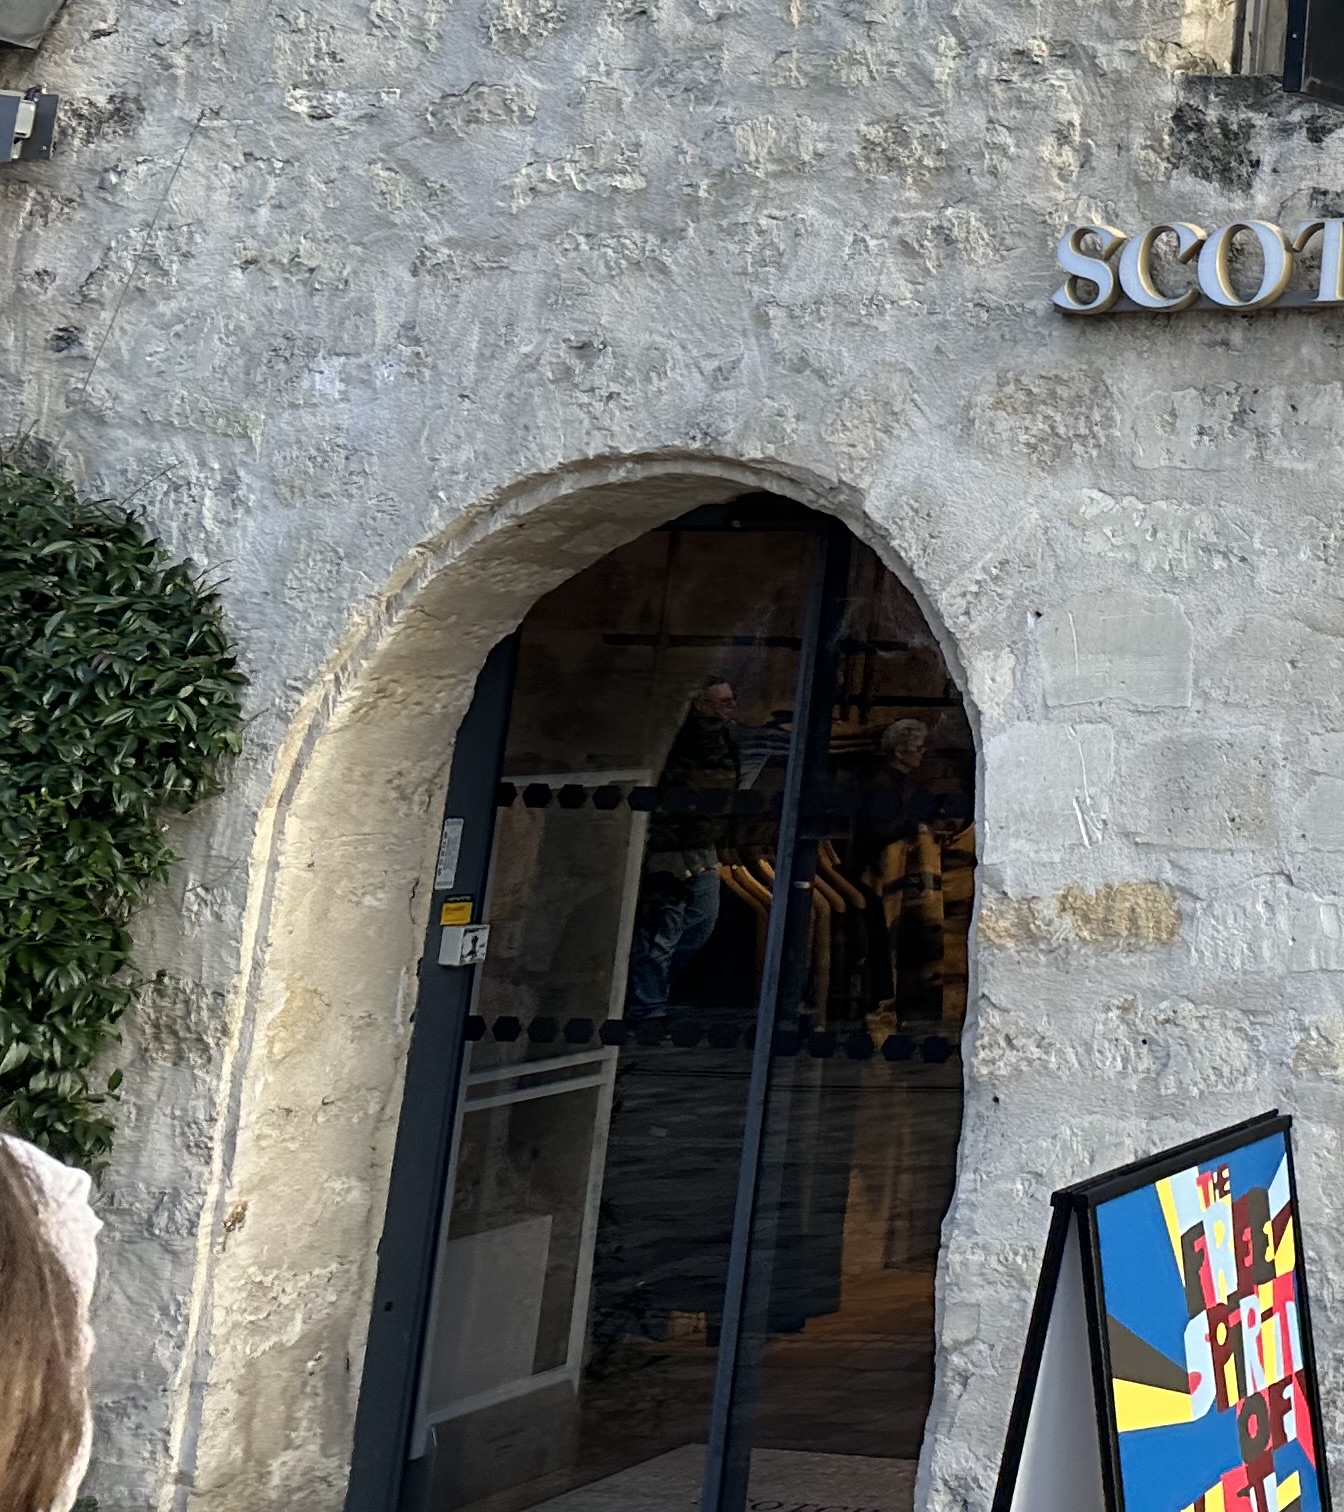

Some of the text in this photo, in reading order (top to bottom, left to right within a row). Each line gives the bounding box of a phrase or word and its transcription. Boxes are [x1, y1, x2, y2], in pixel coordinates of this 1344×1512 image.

[1196, 1163, 1231, 1210] THE
[1181, 1187, 1276, 1319] FREE
[1184, 1274, 1303, 1422] SPIRIT
[1238, 1374, 1302, 1464] OF
